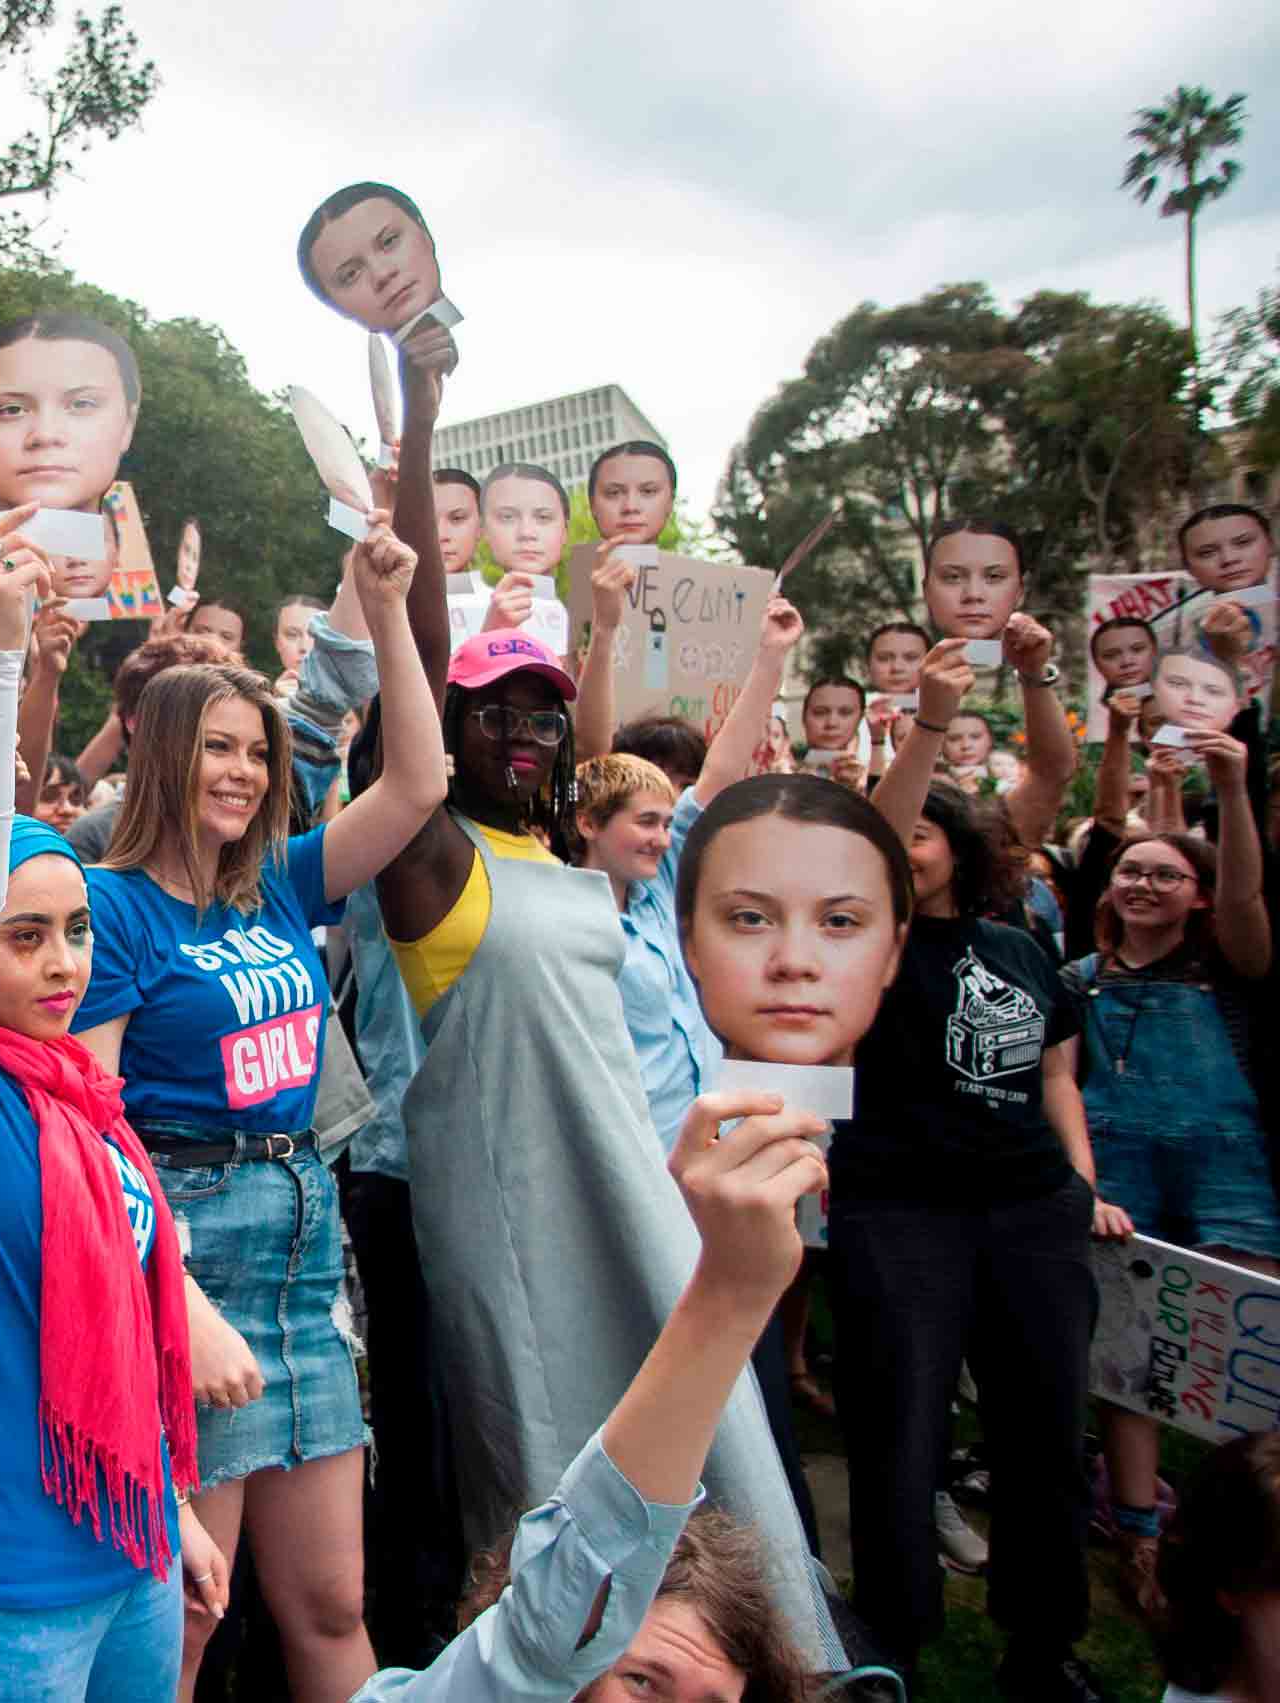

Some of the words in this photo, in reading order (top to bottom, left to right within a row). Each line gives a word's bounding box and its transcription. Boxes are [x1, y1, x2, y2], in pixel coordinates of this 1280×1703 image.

[219, 957, 315, 1025] WITH
[232, 1015, 320, 1096] GIRLS
[1156, 1264, 1193, 1335] OUR
